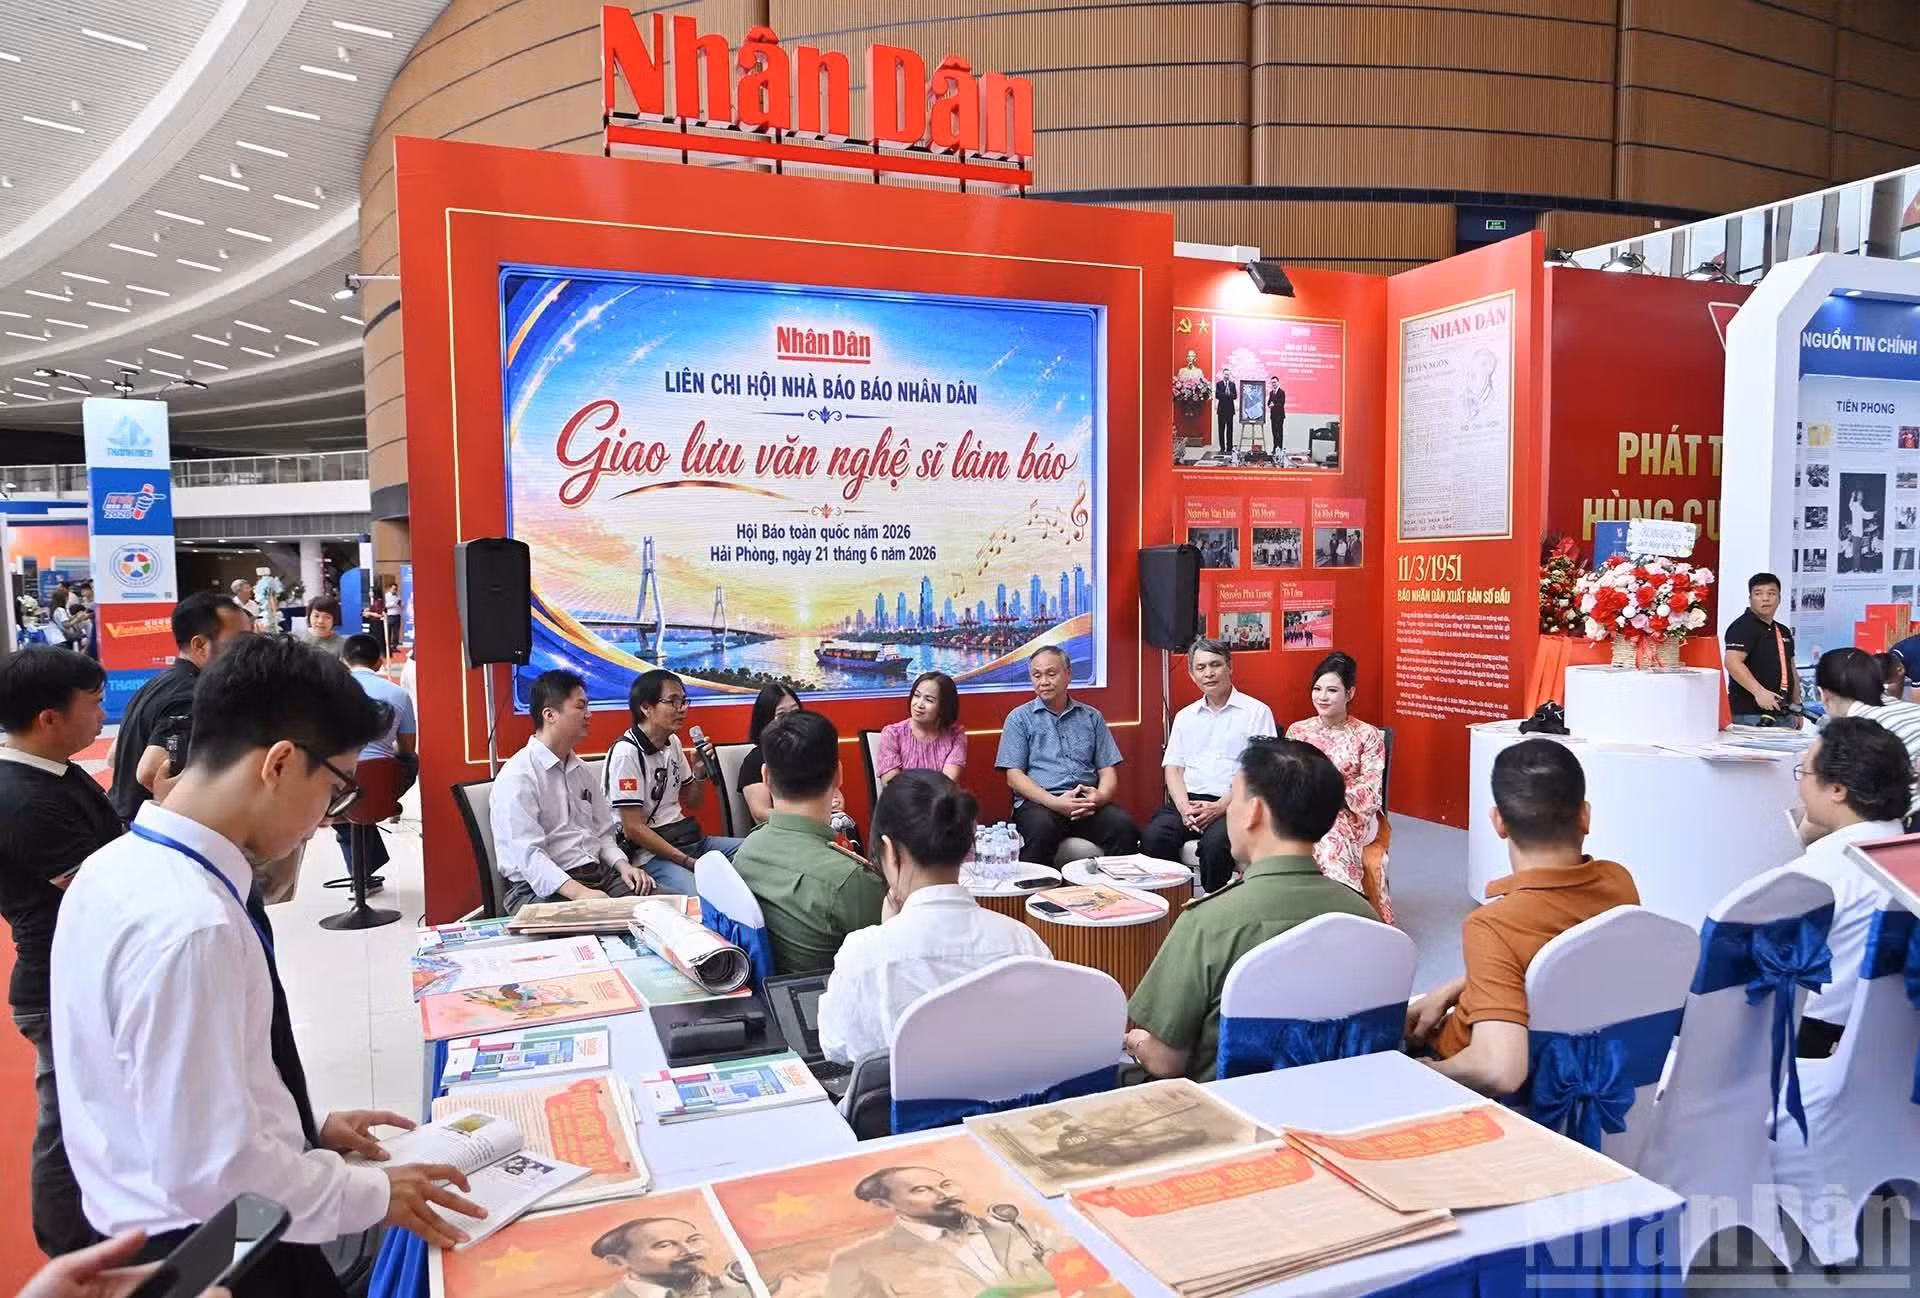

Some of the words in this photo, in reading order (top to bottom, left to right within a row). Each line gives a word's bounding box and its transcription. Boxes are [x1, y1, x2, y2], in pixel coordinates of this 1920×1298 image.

[602, 5, 850, 137] Nhân
[866, 43, 1033, 157] Dân
[777, 326, 829, 355] Nhân
[833, 330, 871, 357] Dân
[1802, 327, 1851, 350] NGUỒN
[1853, 336, 1875, 352] TIN
[1878, 334, 1917, 355] CHÍNH
[665, 367, 704, 393] LIÊN
[711, 373, 740, 395] CHI
[747, 371, 776, 401] HỘI
[782, 373, 817, 398] NHÀ
[823, 374, 855, 400] BÁO
[861, 376, 892, 401] BÁO
[898, 378, 941, 403] NHÂN
[947, 380, 977, 405] DÂN
[1861, 402, 1895, 414] PHONG
[556, 399, 671, 506] Giao
[681, 420, 744, 474] lưu
[755, 435, 819, 476] văn
[827, 426, 910, 500] nghệ
[916, 442, 948, 478] sĩ
[952, 429, 1009, 479] làm
[1016, 431, 1078, 480] báo
[1618, 424, 1702, 476] PHÁT
[737, 523, 757, 542] Hội
[762, 523, 785, 539] Báo
[789, 524, 816, 539] toàn
[820, 522, 850, 542] quốc
[854, 524, 878, 539] năm
[882, 524, 911, 539] 2026
[711, 545, 731, 561] Hải
[736, 546, 779, 565] Phòng,
[782, 546, 812, 565] ngày
[815, 546, 828, 561] 21
[833, 545, 867, 564] tháng
[870, 546, 878, 560] 6
[881, 546, 905, 561] năm
[909, 546, 936, 561] 2026
[1397, 553, 1462, 582] 11/3/1951
[1397, 587, 1410, 602] BÁO
[1412, 587, 1430, 602] NHÂN
[1431, 587, 1446, 602] DÂN
[1447, 586, 1465, 603] XUẤT
[1483, 587, 1494, 604] SỐ
